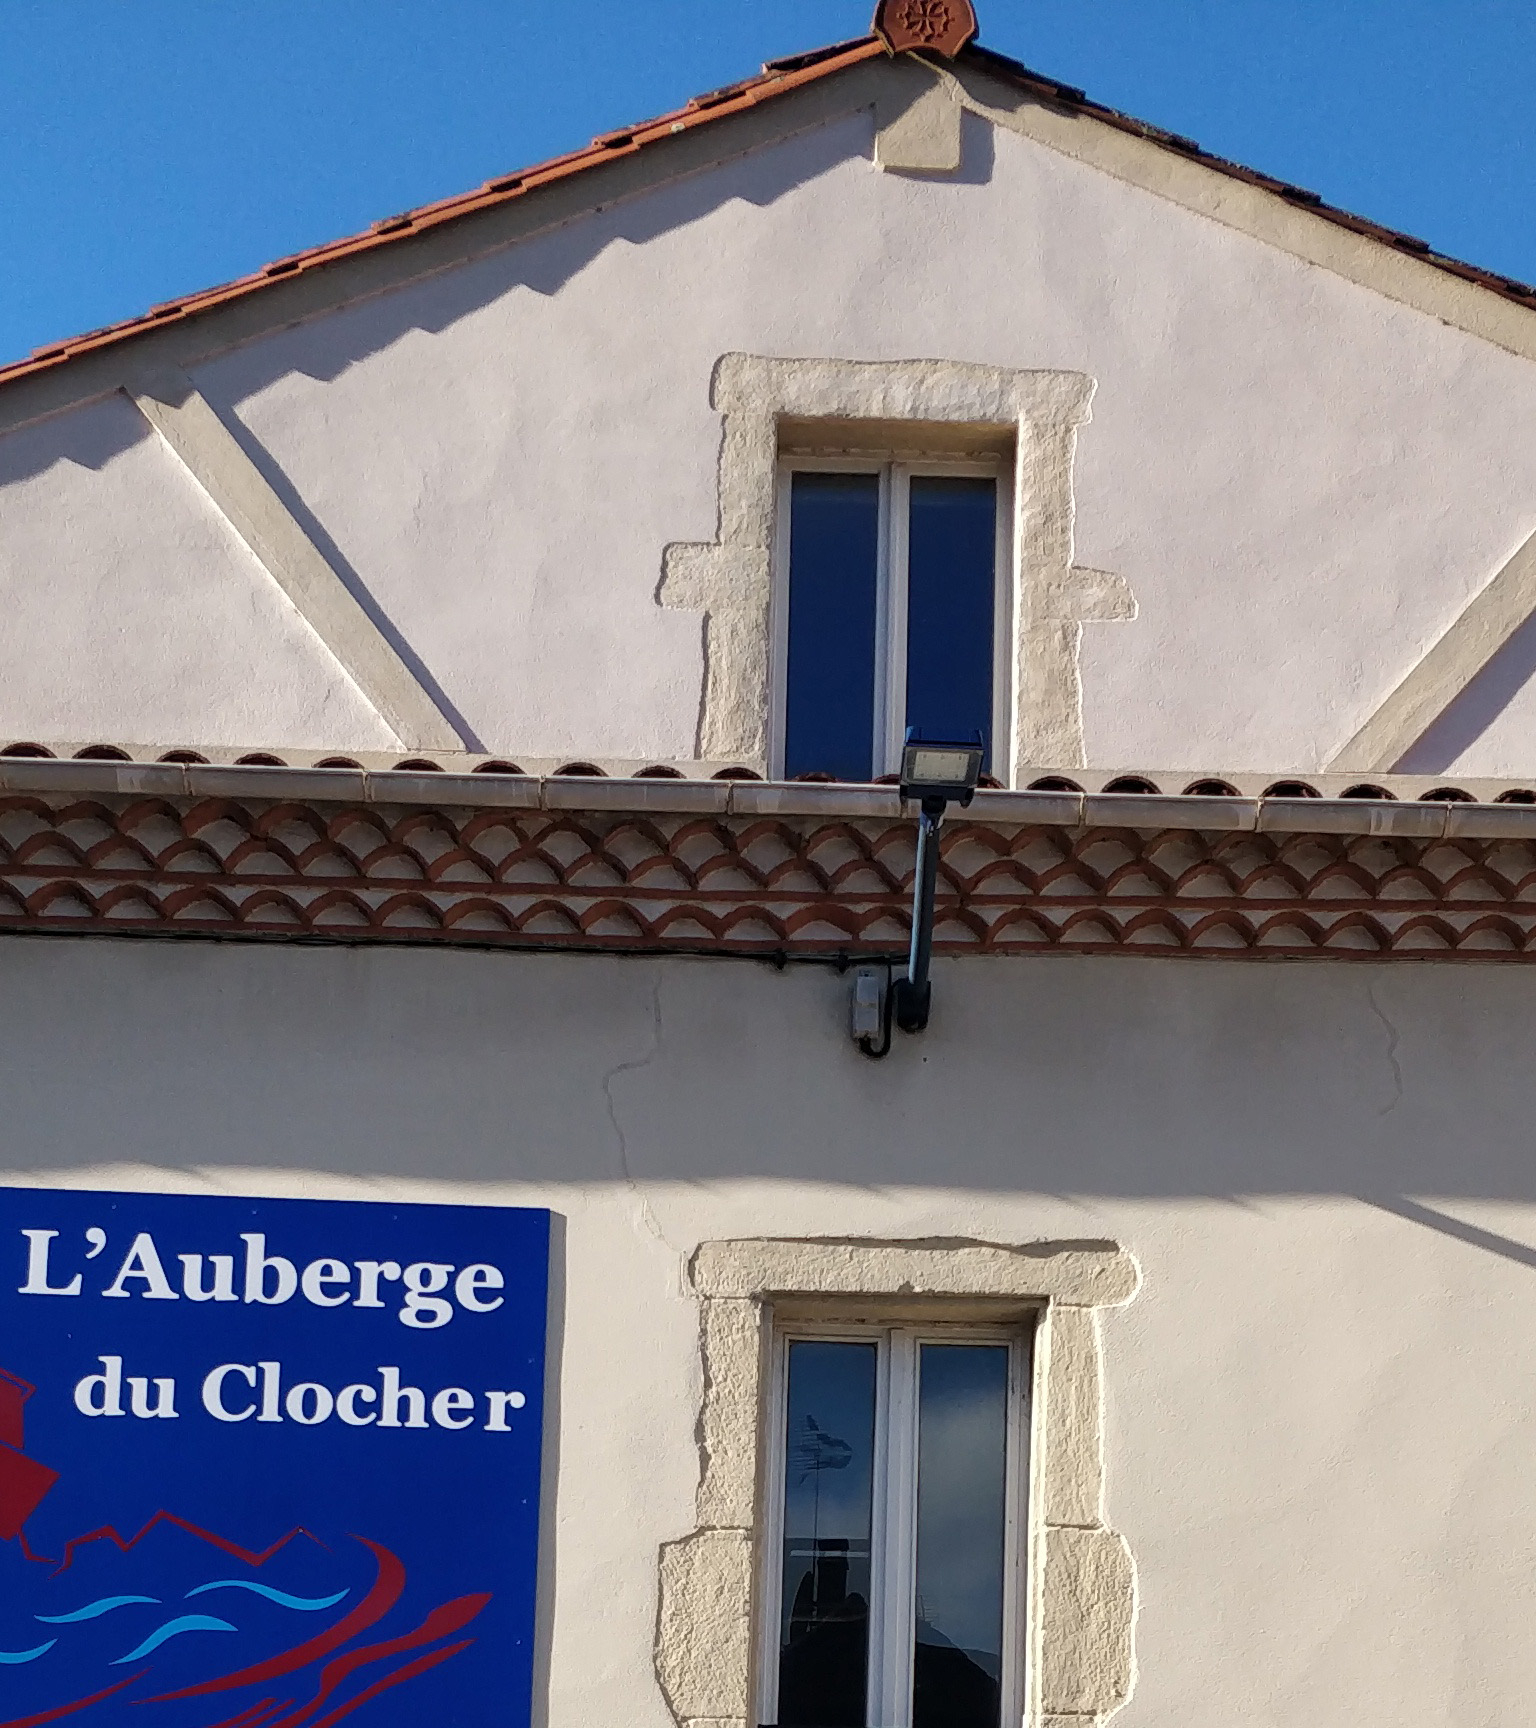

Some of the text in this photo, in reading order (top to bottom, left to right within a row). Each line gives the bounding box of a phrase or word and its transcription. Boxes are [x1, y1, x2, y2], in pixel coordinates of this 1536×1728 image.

[17, 1227, 505, 1329] L'Auberge
[73, 1356, 526, 1432] du Clocher
